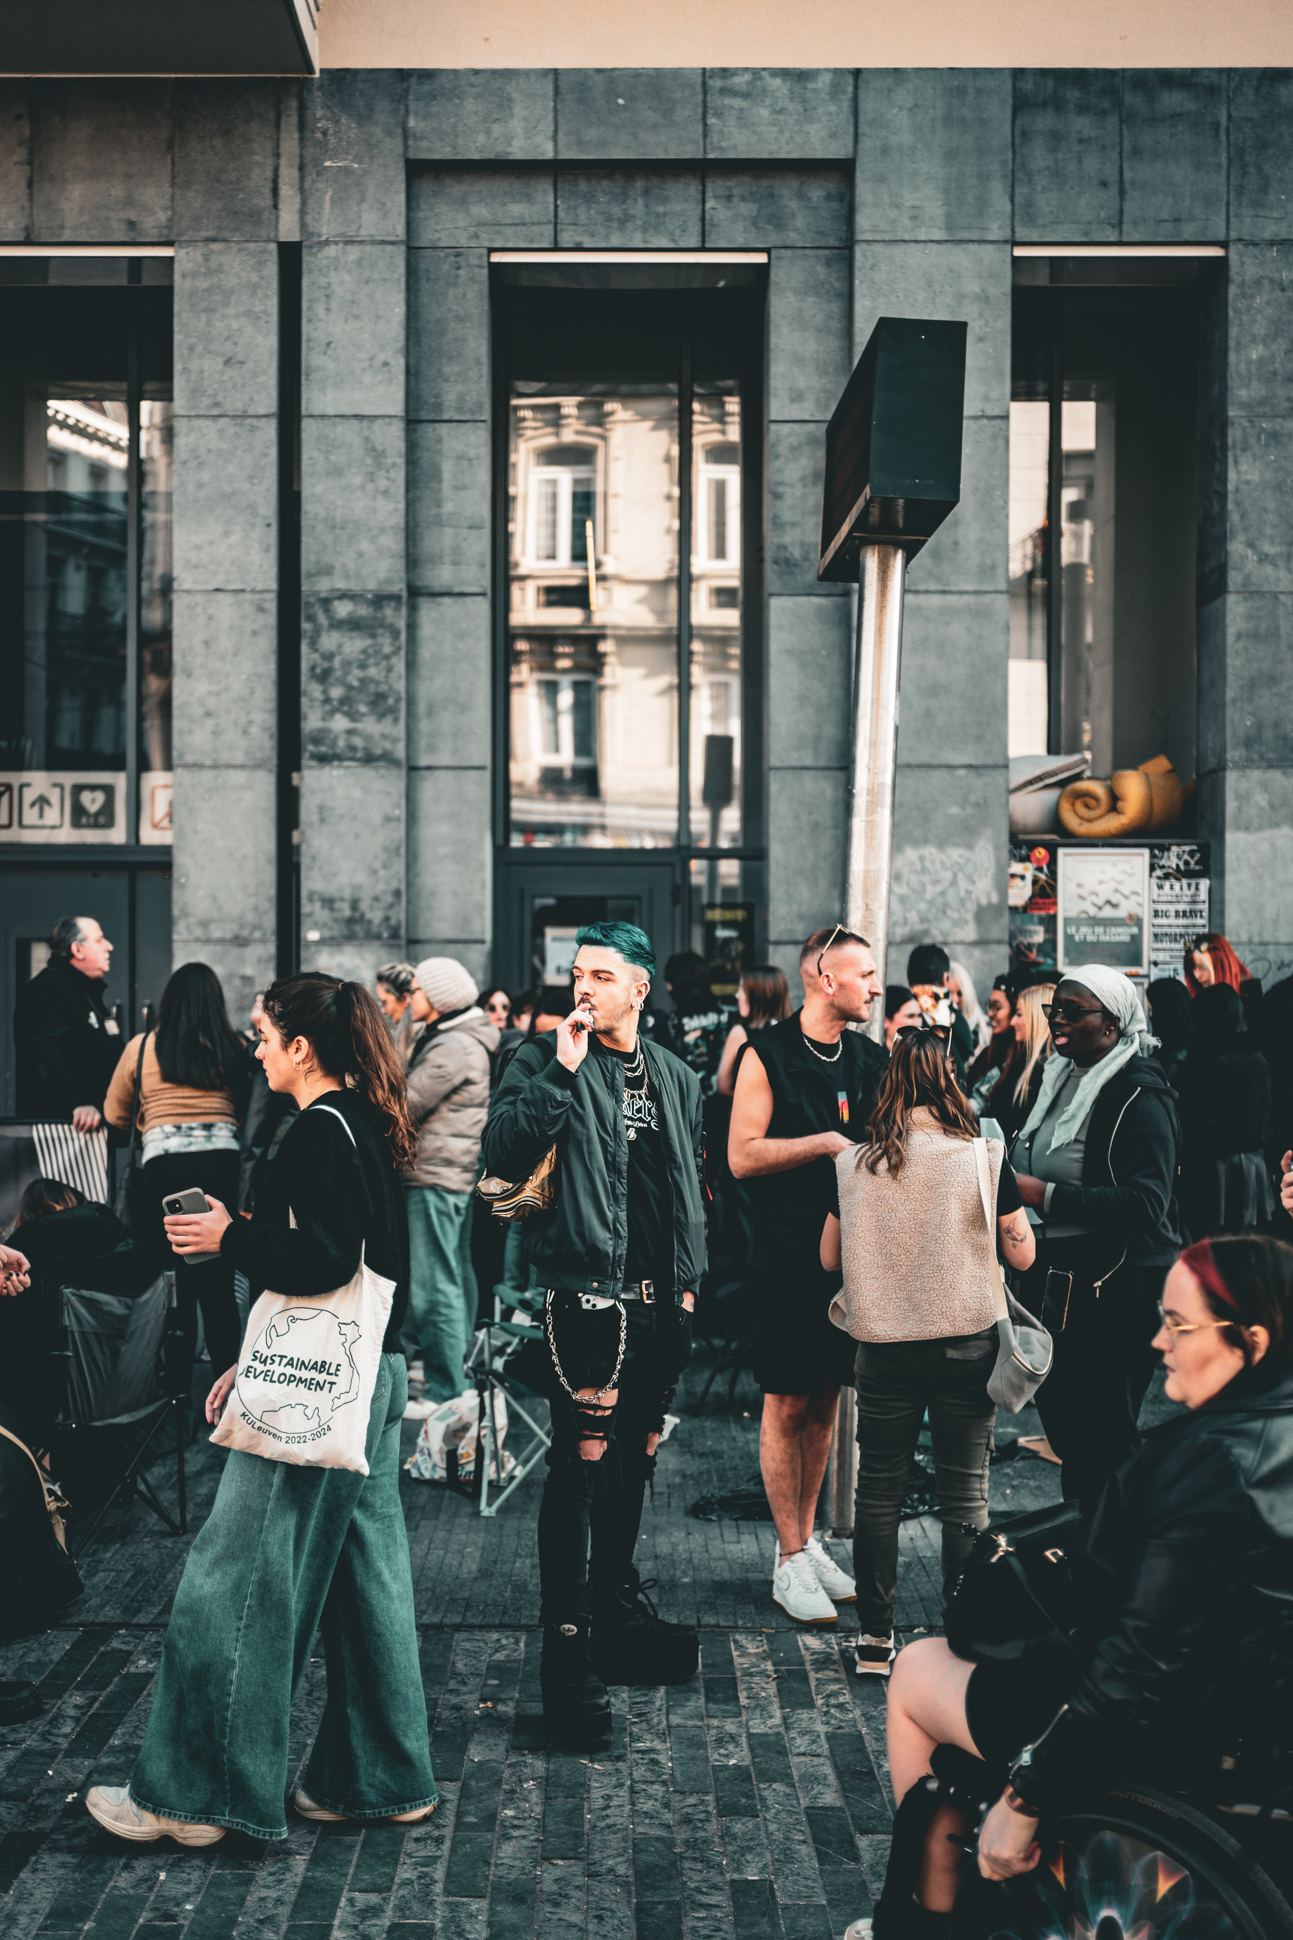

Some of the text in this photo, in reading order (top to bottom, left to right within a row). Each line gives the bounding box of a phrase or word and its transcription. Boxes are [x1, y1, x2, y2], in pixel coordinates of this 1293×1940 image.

[1153, 909, 1205, 920] BIG BRAVE
[1066, 925, 1077, 935] LE
[1094, 925, 1106, 935] DE
[1074, 934, 1085, 943] ET
[250, 1350, 342, 1377] SUSTAINABLE
[285, 1424, 332, 1444] 2022-2024
